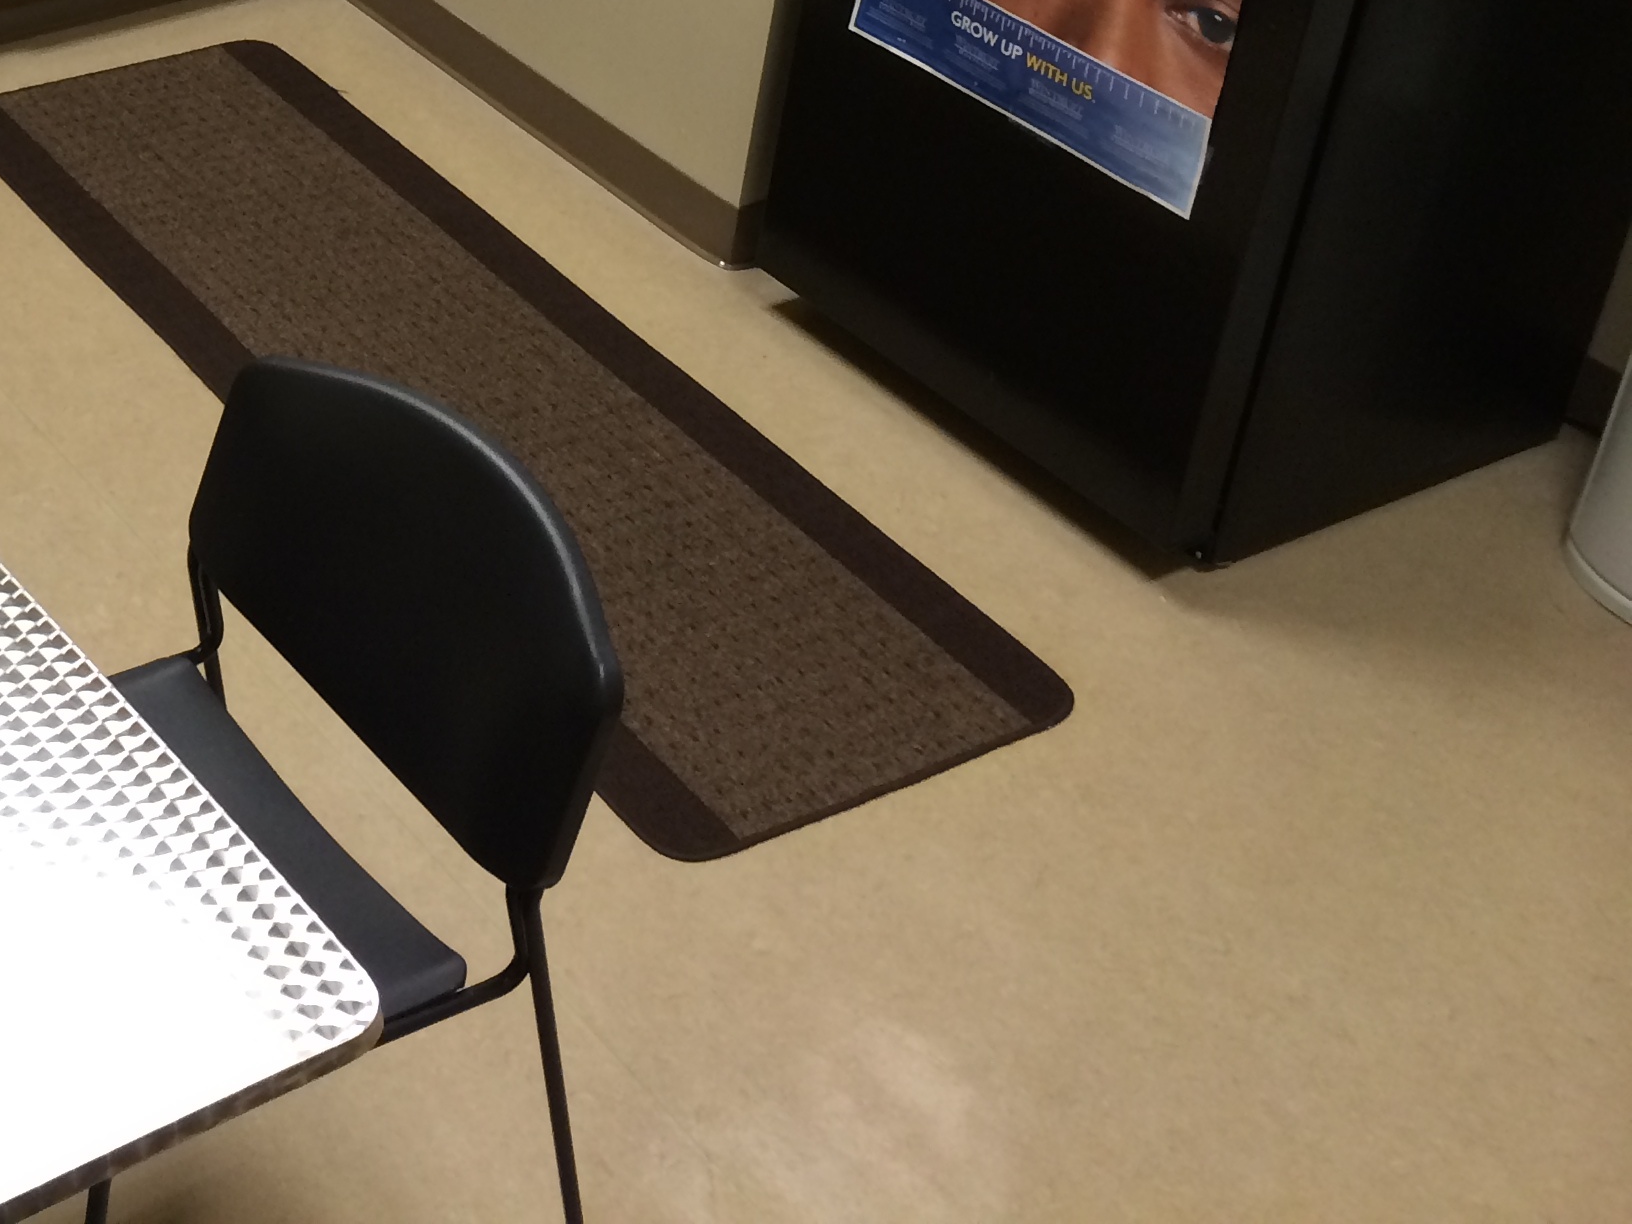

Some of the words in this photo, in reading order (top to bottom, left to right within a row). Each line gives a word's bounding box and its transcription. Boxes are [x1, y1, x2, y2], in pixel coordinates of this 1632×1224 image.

[951, 10, 999, 47] GROW
[1000, 39, 1023, 60] UP
[1025, 52, 1069, 87] WITH
[1071, 78, 1096, 104] US.
